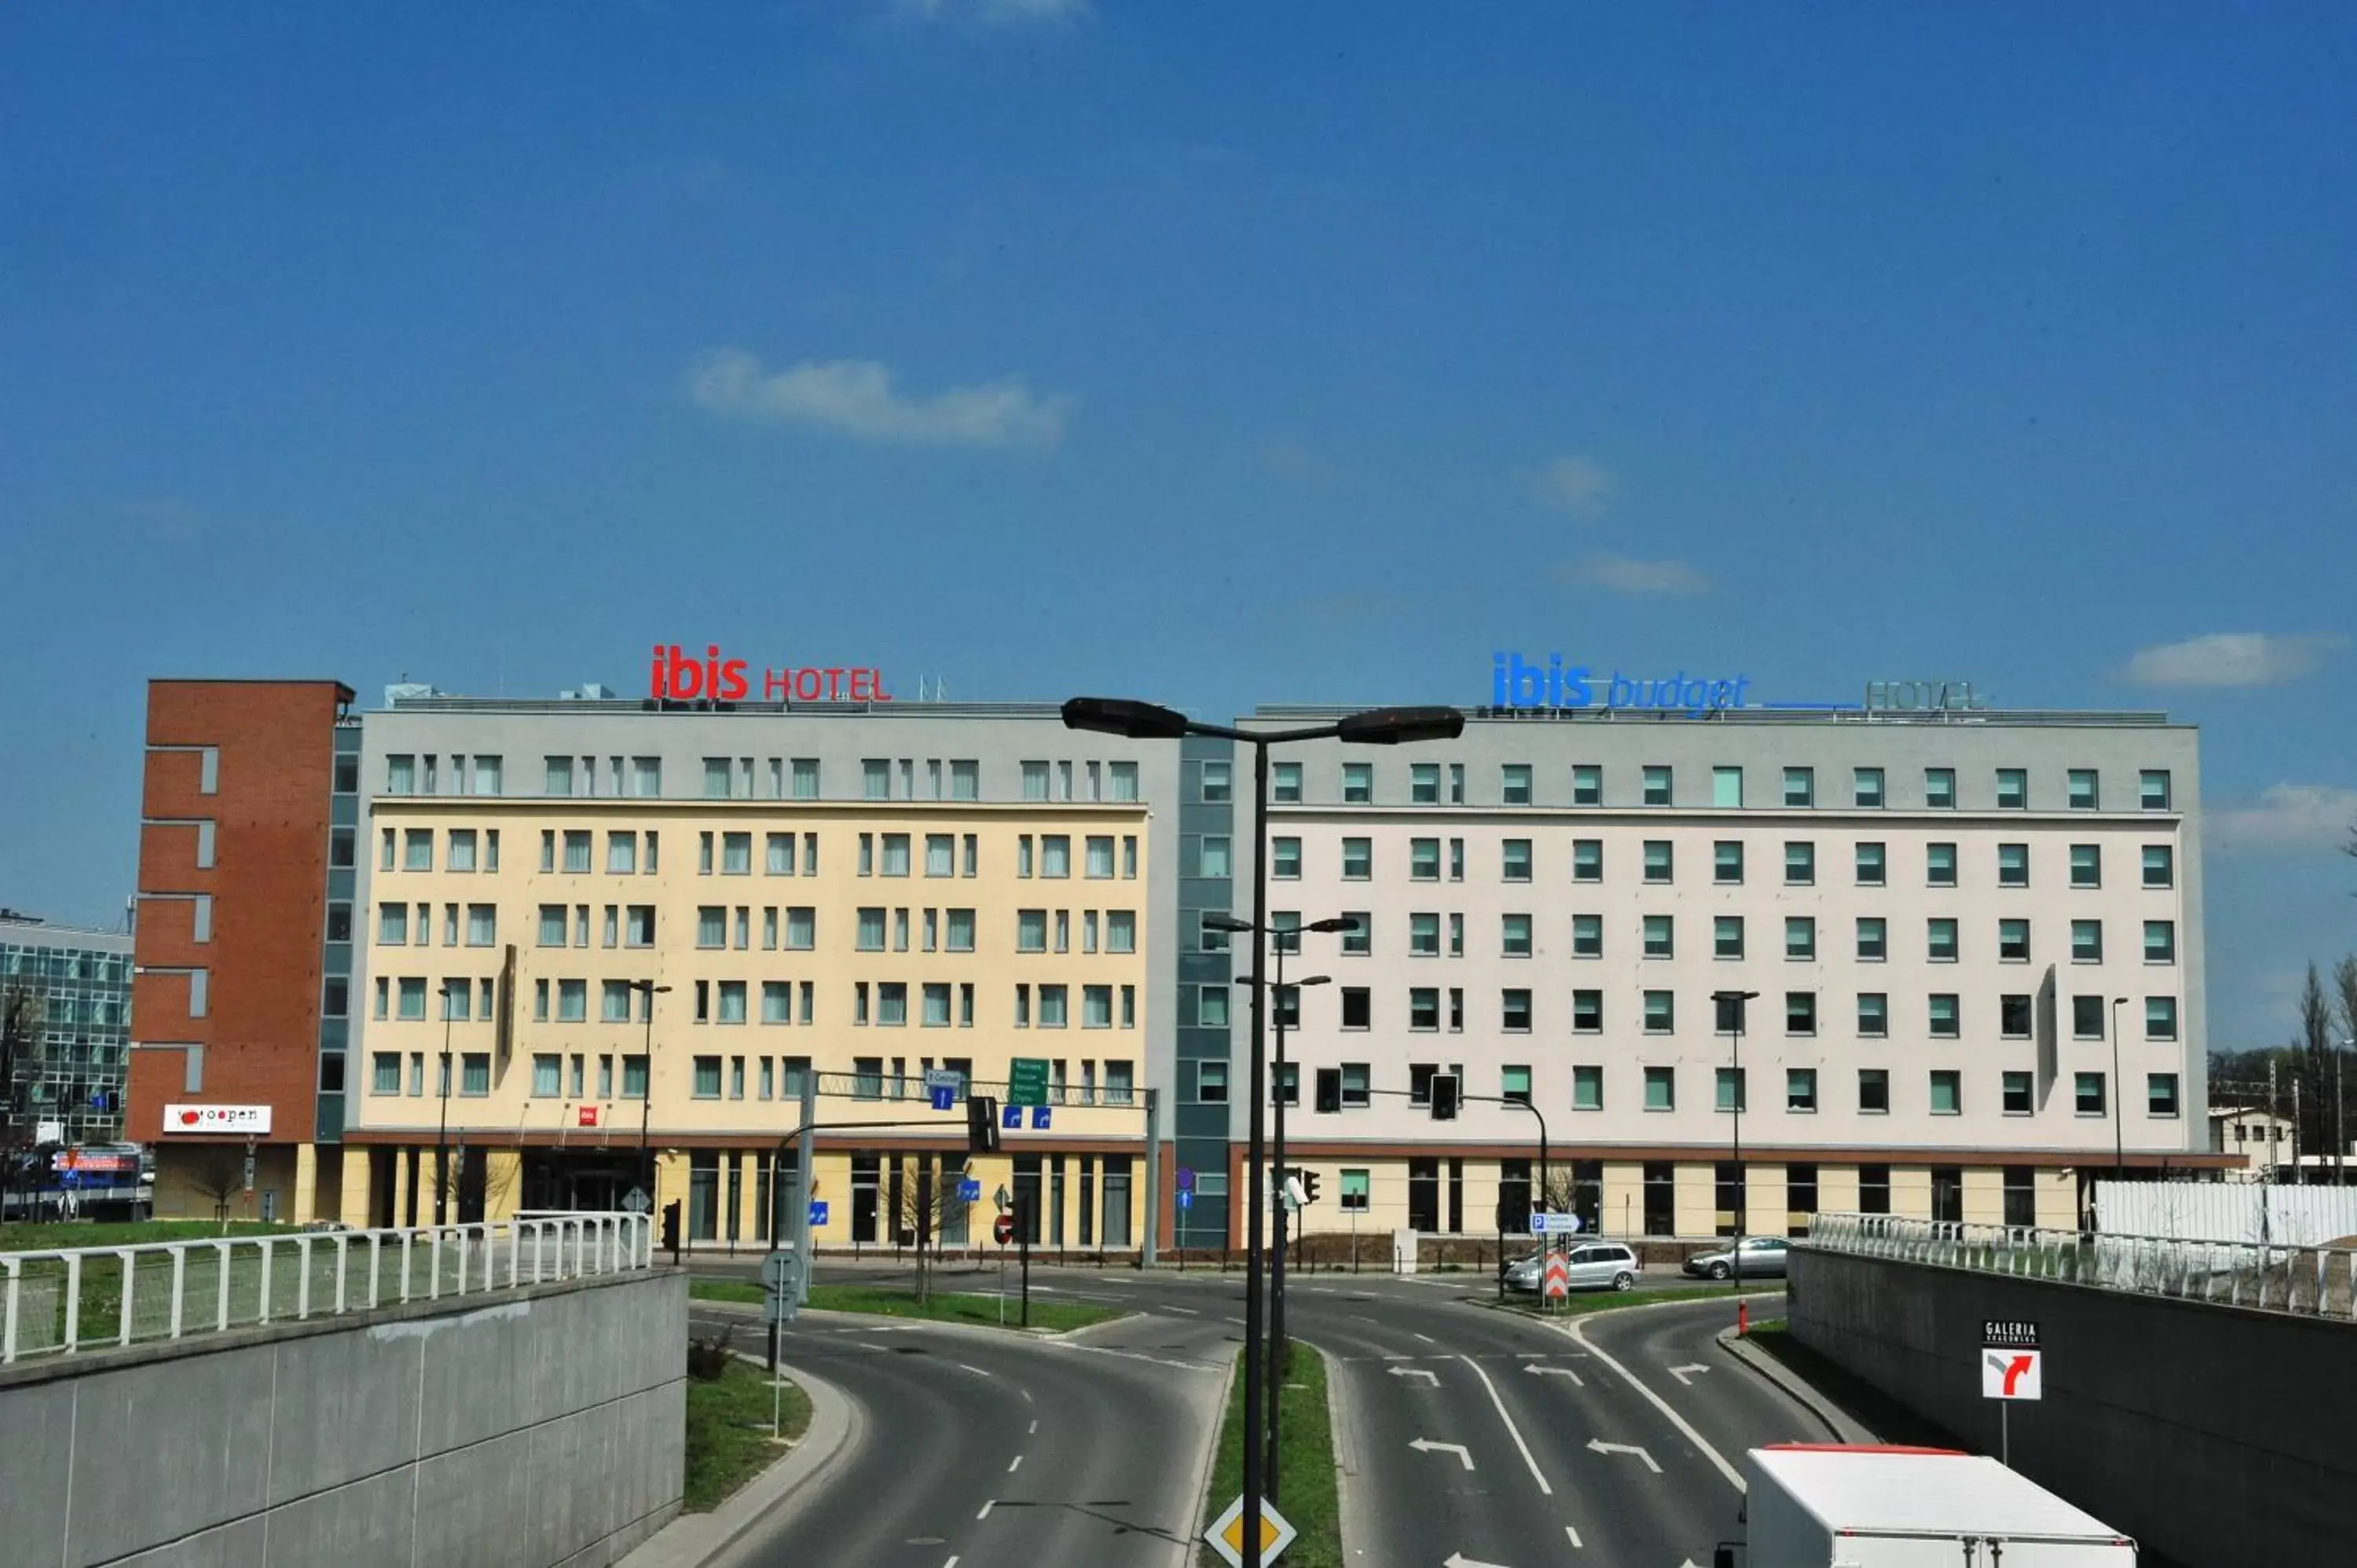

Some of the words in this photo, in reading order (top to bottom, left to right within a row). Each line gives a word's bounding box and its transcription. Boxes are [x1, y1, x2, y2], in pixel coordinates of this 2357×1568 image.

[651, 644, 749, 699] ibis
[764, 667, 892, 702] HOTEL
[1493, 652, 1593, 707] ibis
[1610, 670, 1751, 720] budget
[1985, 1321, 2036, 1336] GALERIA
